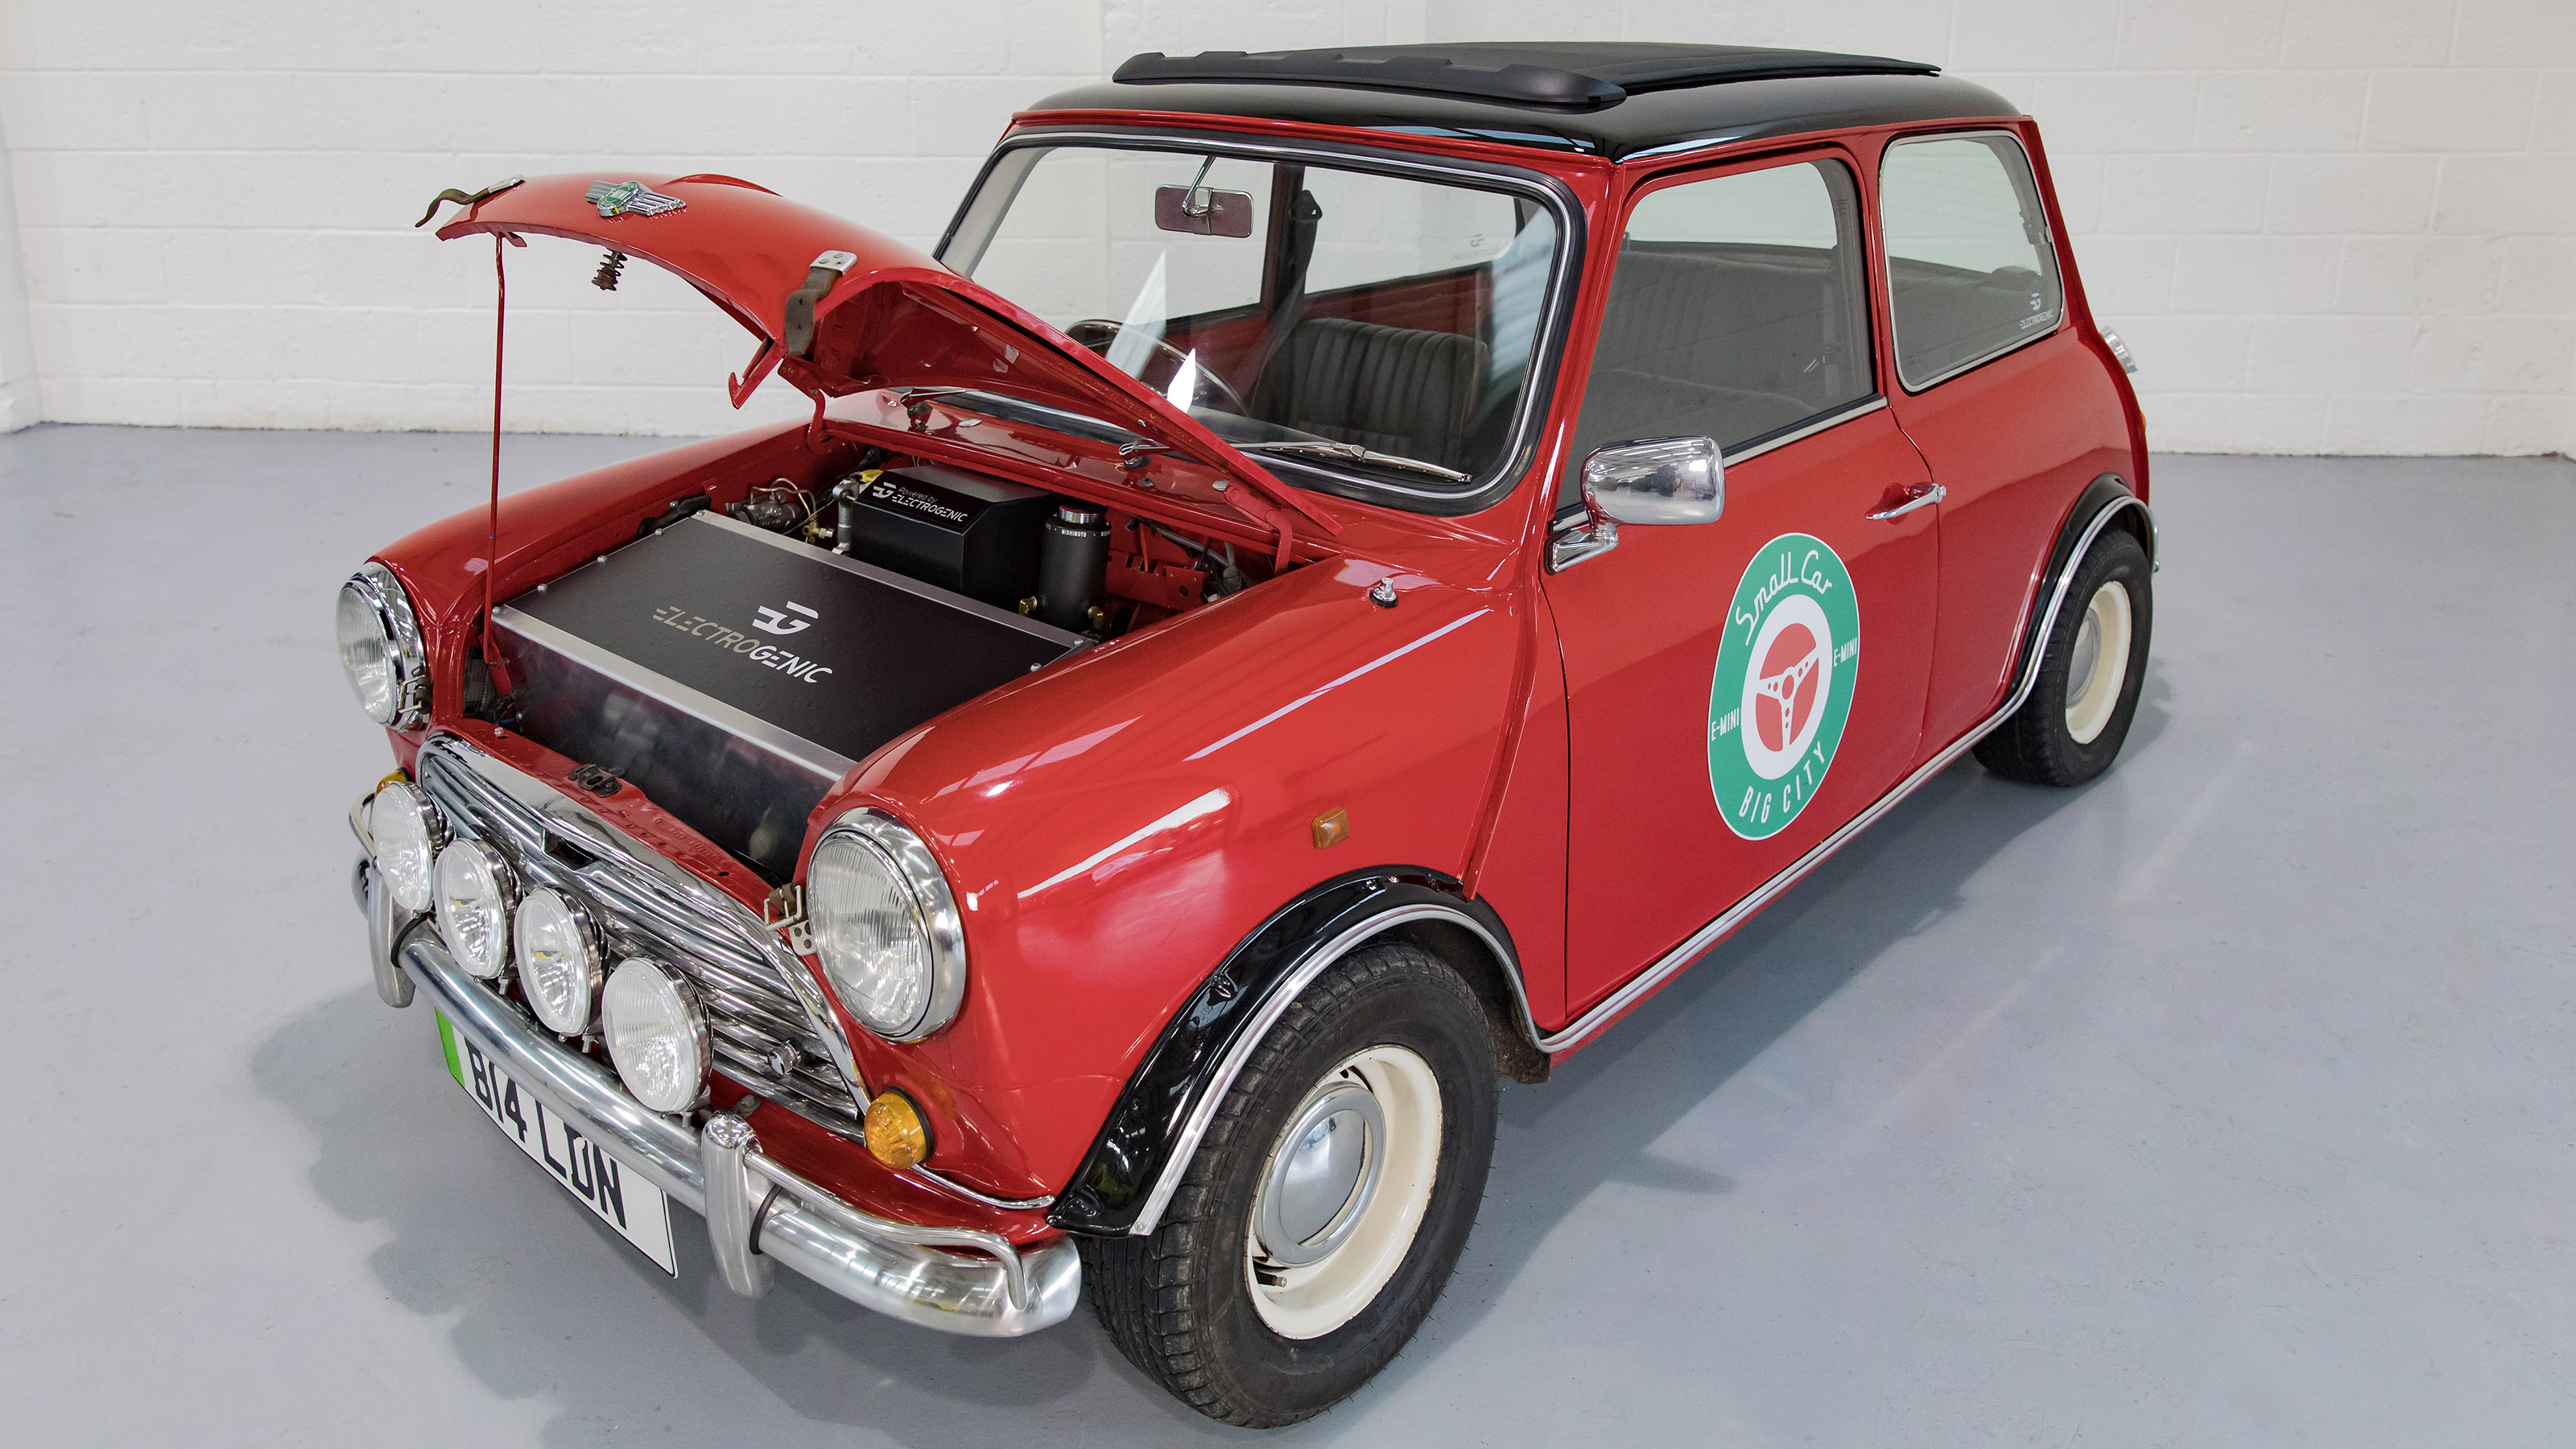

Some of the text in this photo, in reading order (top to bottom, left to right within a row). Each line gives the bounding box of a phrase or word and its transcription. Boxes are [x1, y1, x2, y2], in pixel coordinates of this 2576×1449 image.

[892, 494, 968, 522] ELECTROGENIC
[898, 486, 939, 504] Powered by
[1061, 529, 1087, 538] MISHIMOTO
[1736, 549, 1833, 646] Small Car
[652, 605, 832, 683] ELECTROGENIC
[1833, 637, 1858, 667] E-MINI
[1711, 707, 1740, 741] E-MINI
[1739, 741, 1825, 824] BIG CITY
[464, 1037, 627, 1231] B14 LDN
